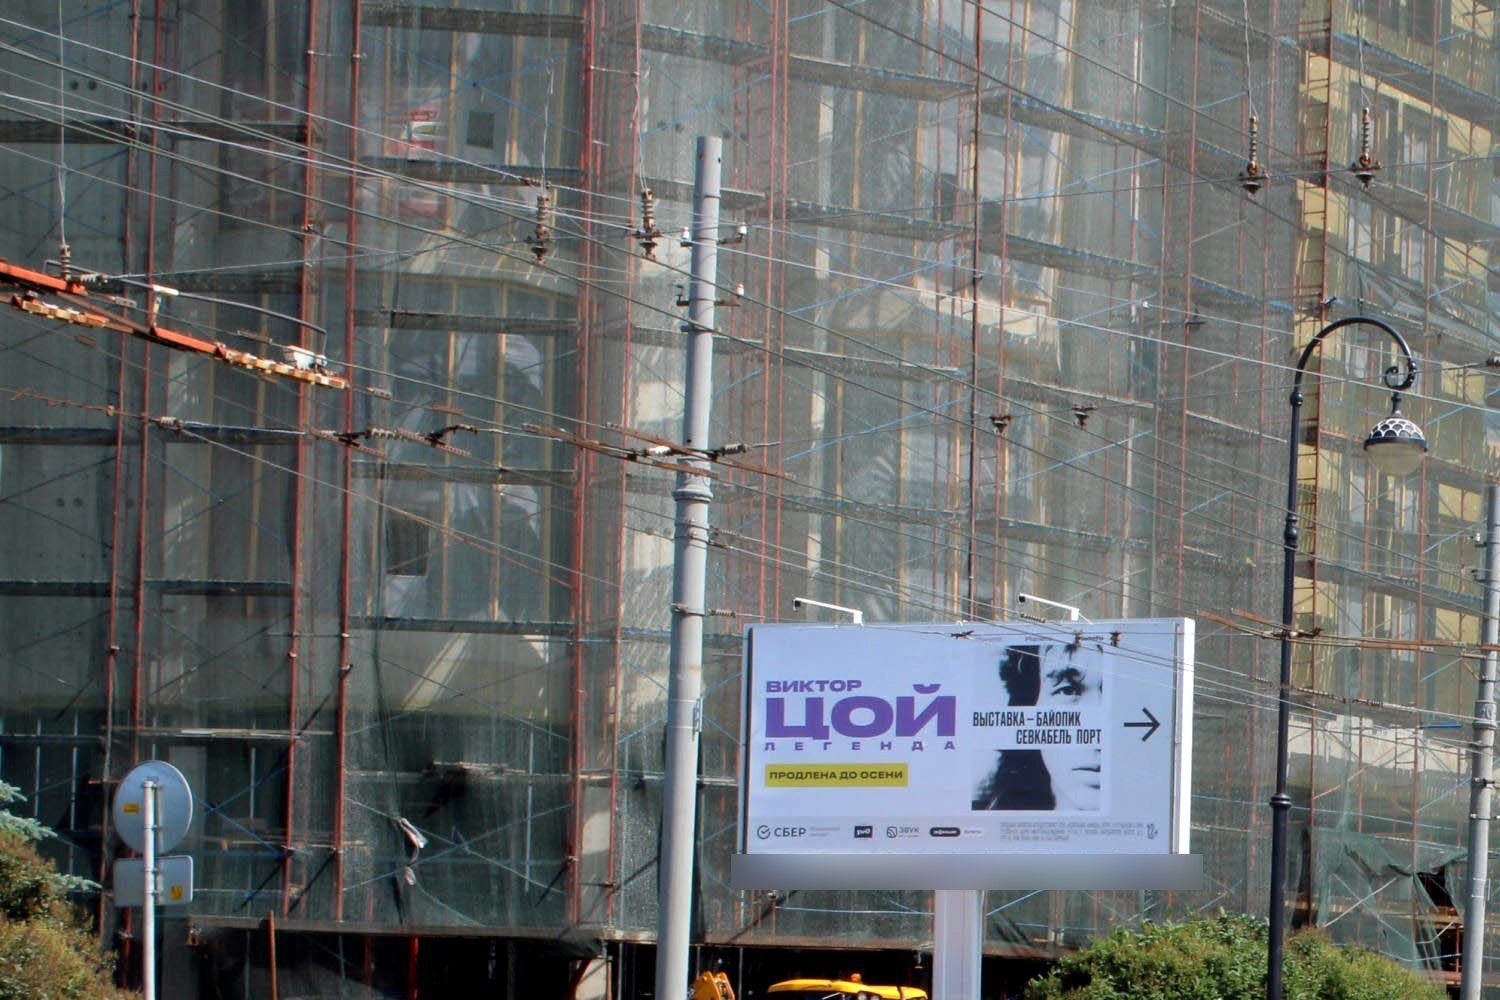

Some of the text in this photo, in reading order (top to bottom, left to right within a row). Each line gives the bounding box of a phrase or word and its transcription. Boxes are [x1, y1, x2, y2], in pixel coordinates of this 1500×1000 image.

[766, 680, 862, 693] ВИКТОР
[765, 683, 956, 740] ЦОЙ
[973, 711, 1025, 726] ВЫСТАВКА
[1036, 710, 1081, 726] БАЙОПИК
[1016, 729, 1102, 744] СЕВКАБЕЛЬ ПОРТ
[764, 741, 956, 751] ЛЕГЕНДА
[769, 770, 903, 780] ПРОДЛЕНА ДО ОСЕНИ
[774, 827, 807, 838] СБЕР
